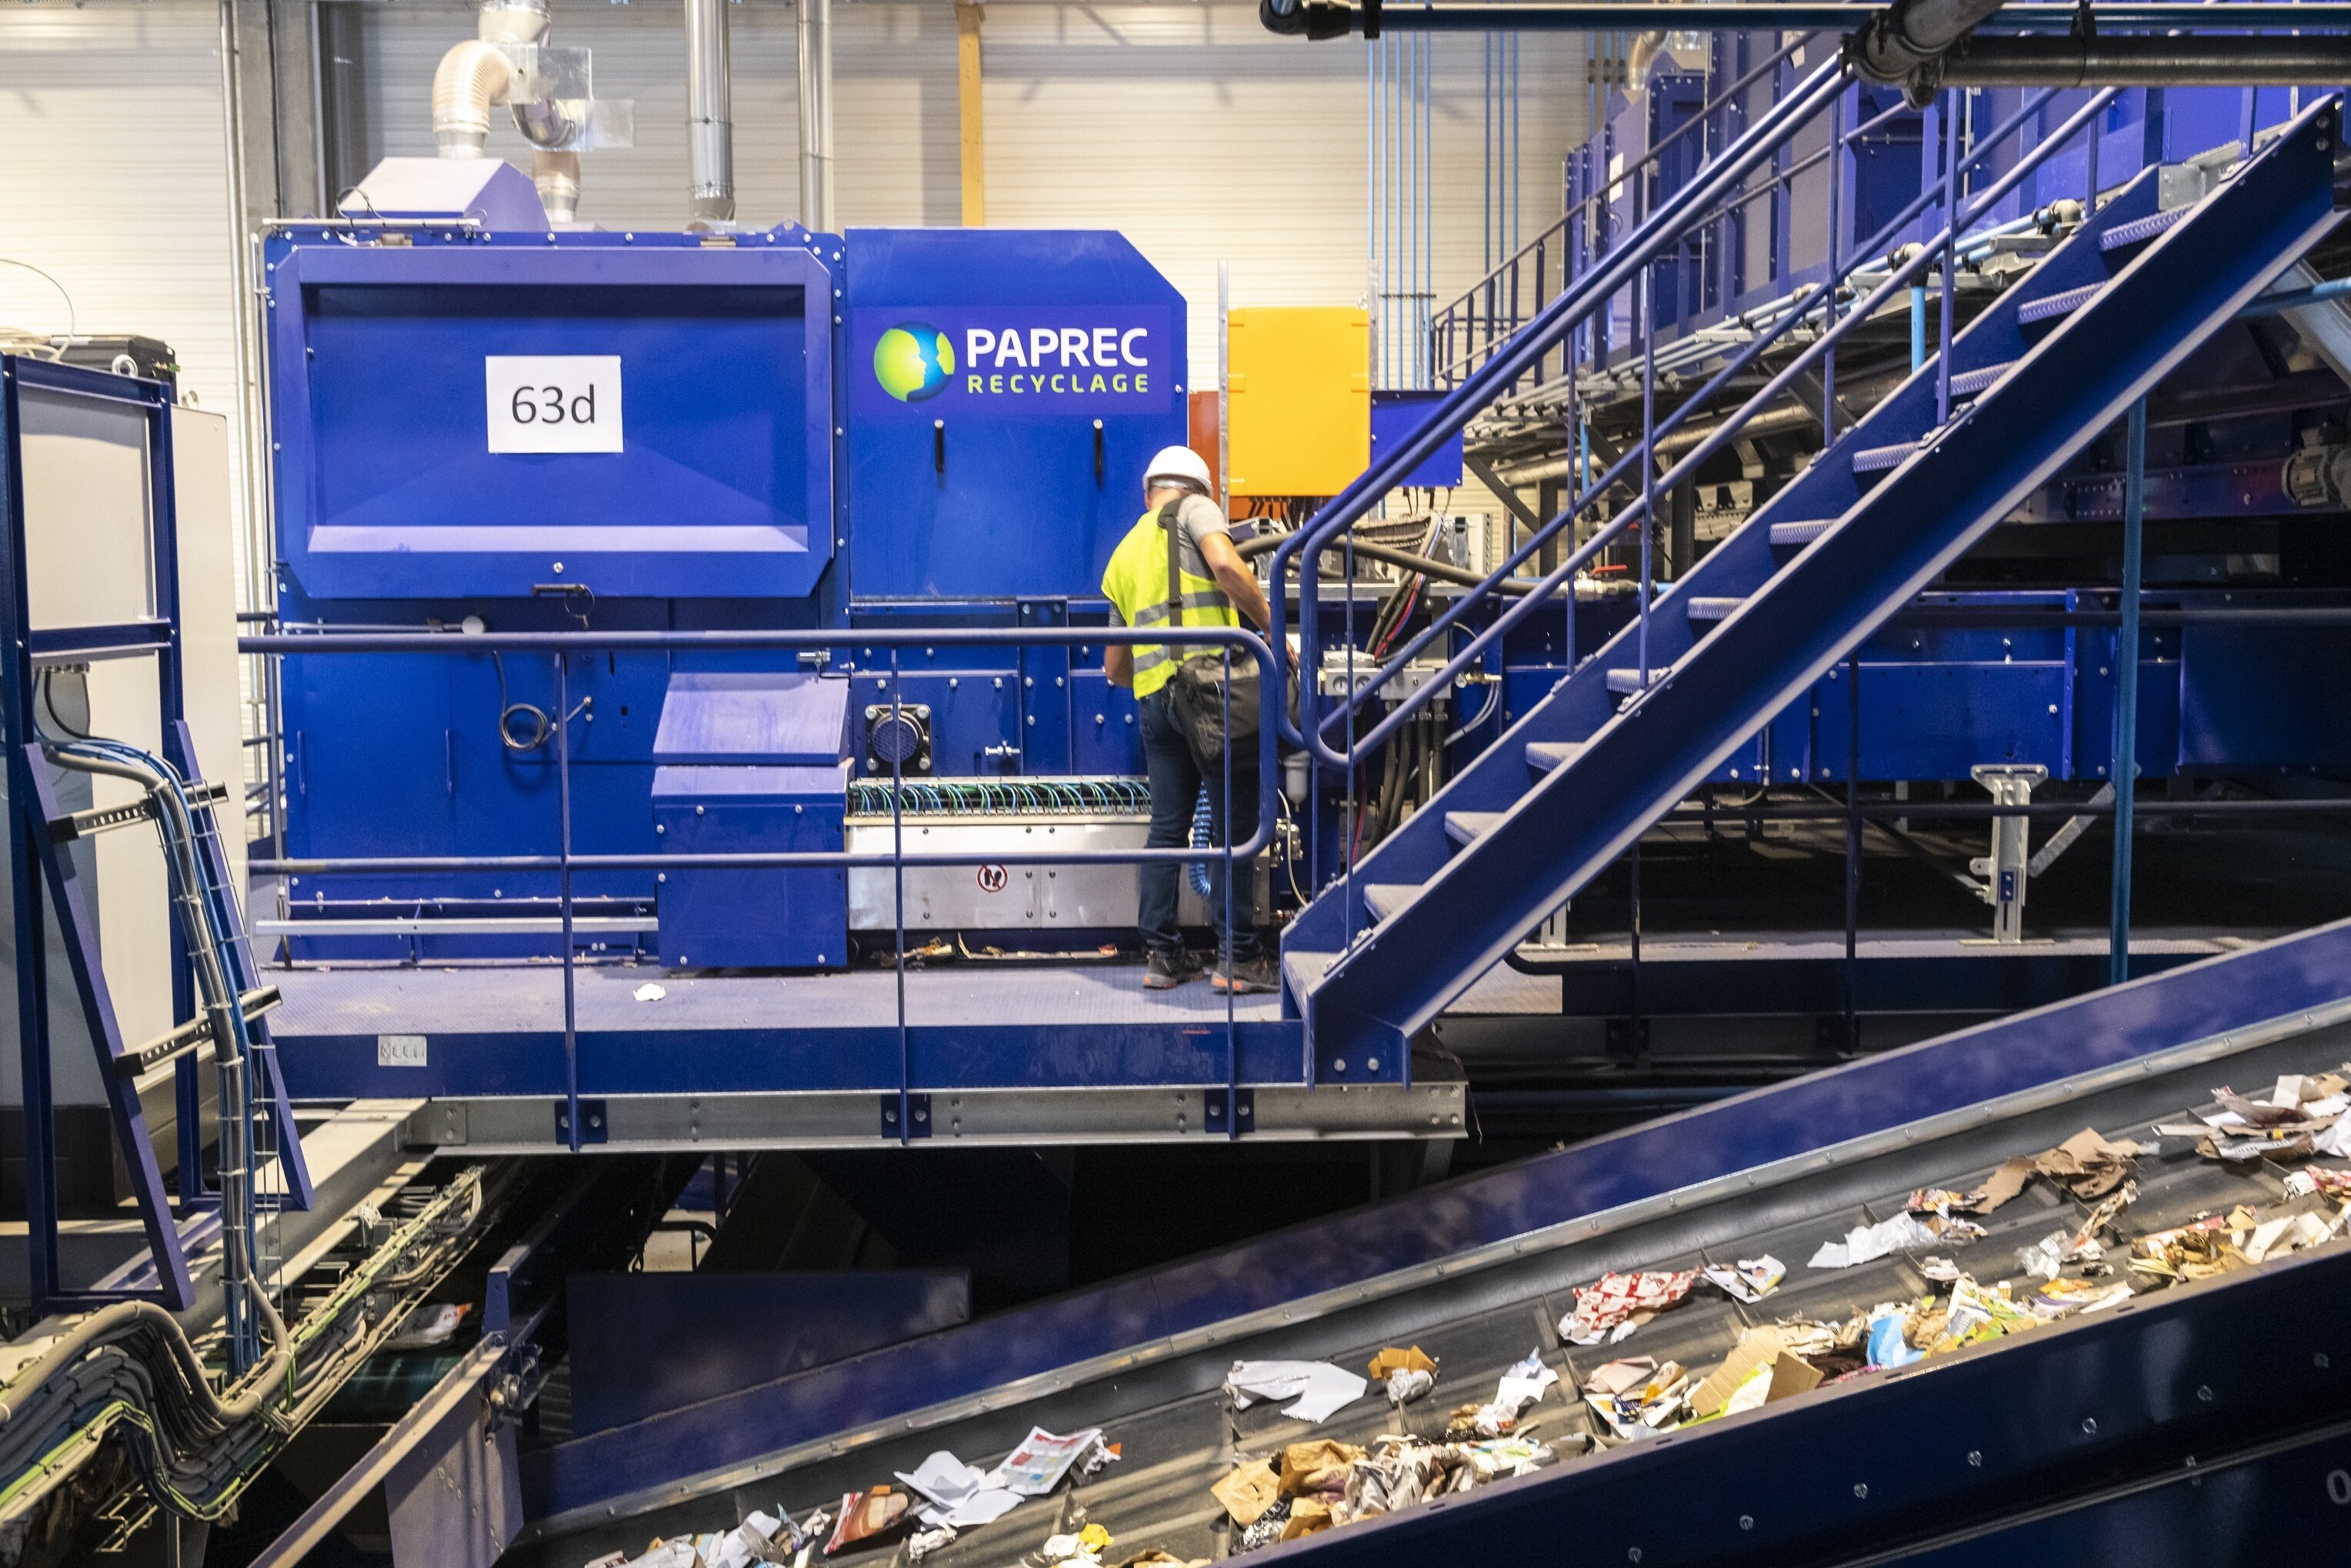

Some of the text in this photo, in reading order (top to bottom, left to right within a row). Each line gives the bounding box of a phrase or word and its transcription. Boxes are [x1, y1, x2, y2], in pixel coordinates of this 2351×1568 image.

[967, 327, 1148, 368] PAPREC
[512, 383, 595, 424] 63d
[969, 374, 1149, 394] RECYCLAGE
